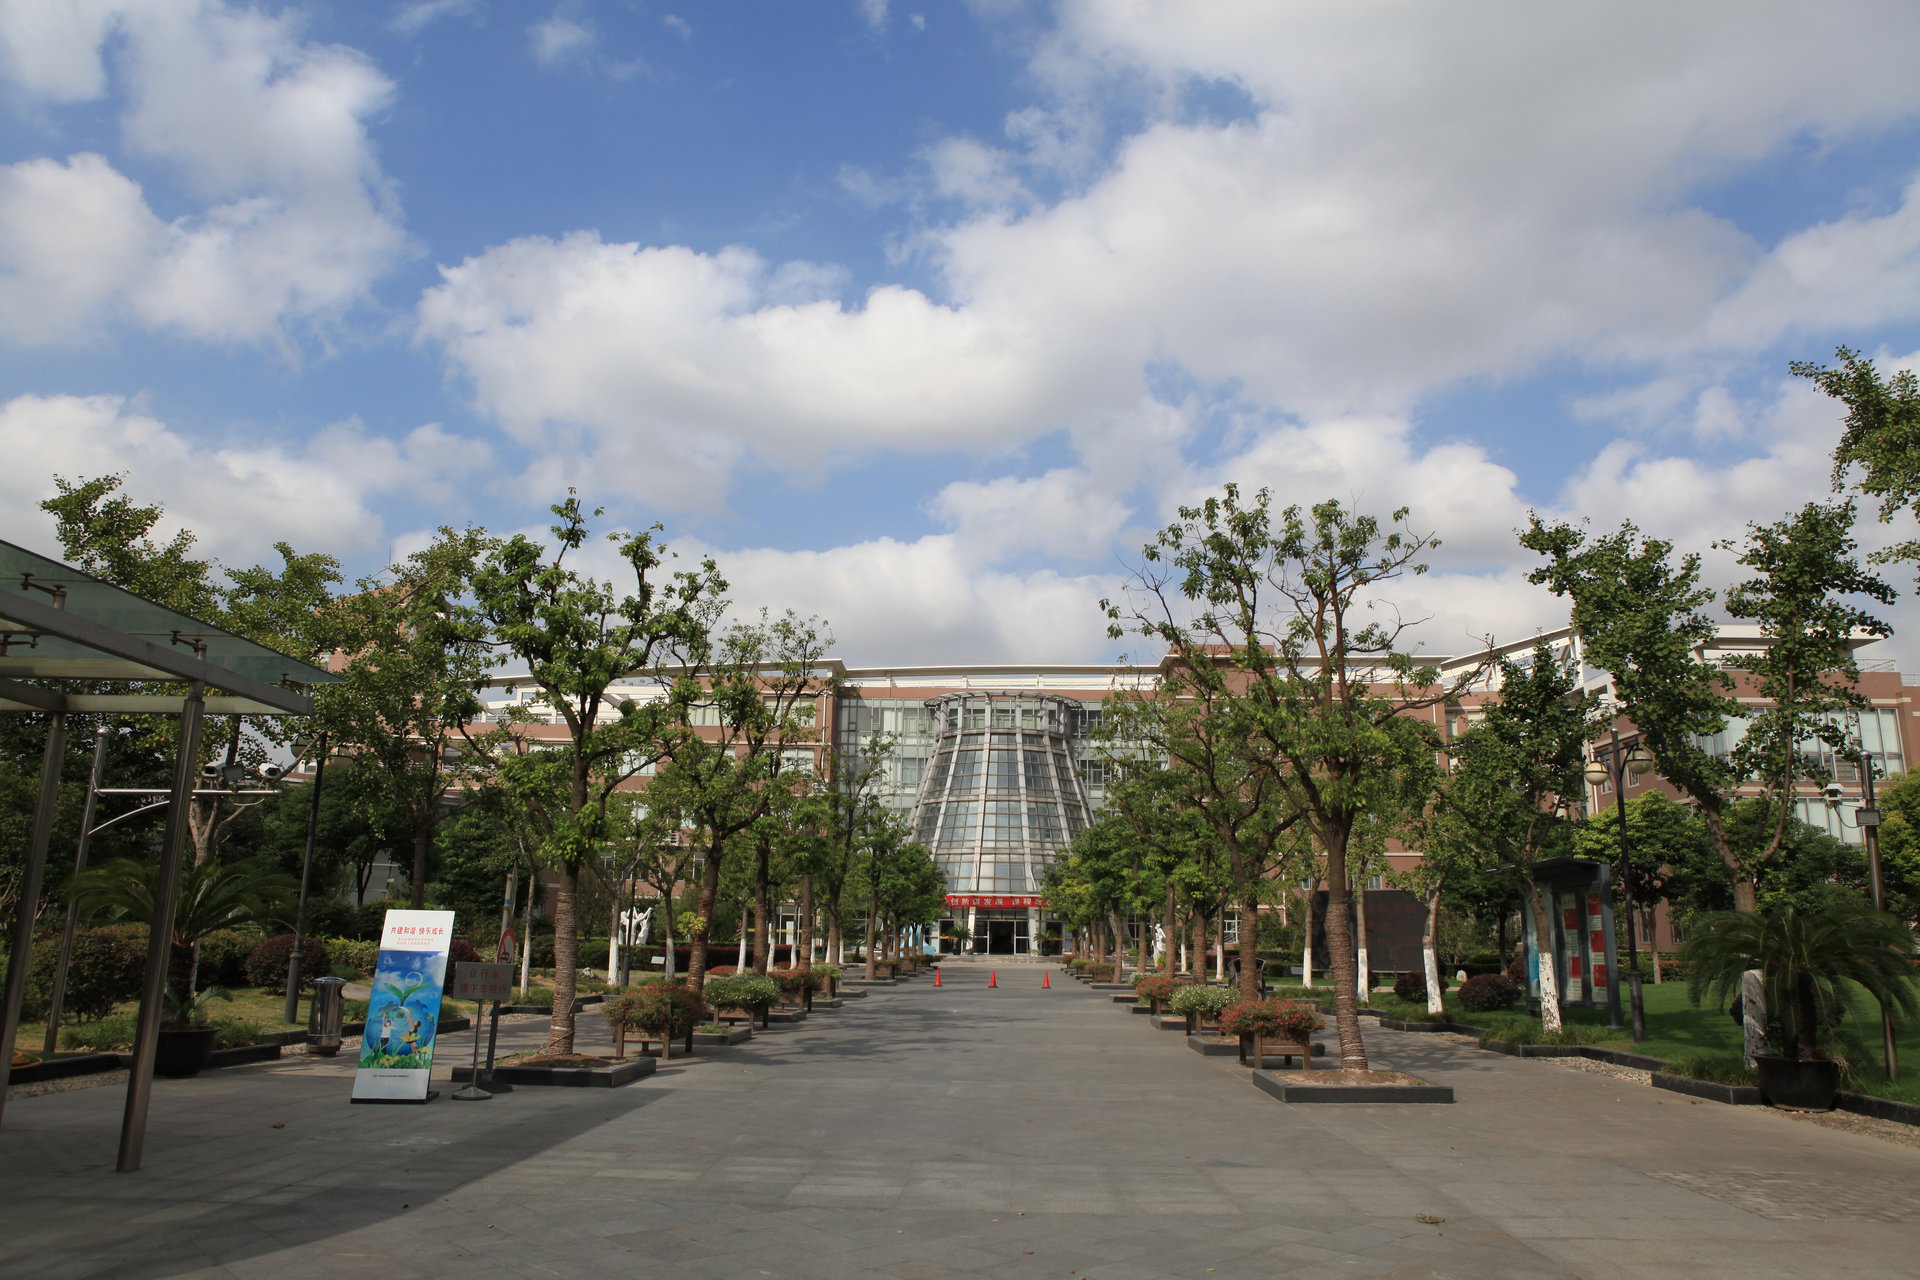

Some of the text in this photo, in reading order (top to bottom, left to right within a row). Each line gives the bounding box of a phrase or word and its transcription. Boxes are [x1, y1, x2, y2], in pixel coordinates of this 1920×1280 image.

[390, 926, 444, 935] 共建和谐 快乐成长
[469, 968, 501, 979] 自行车
